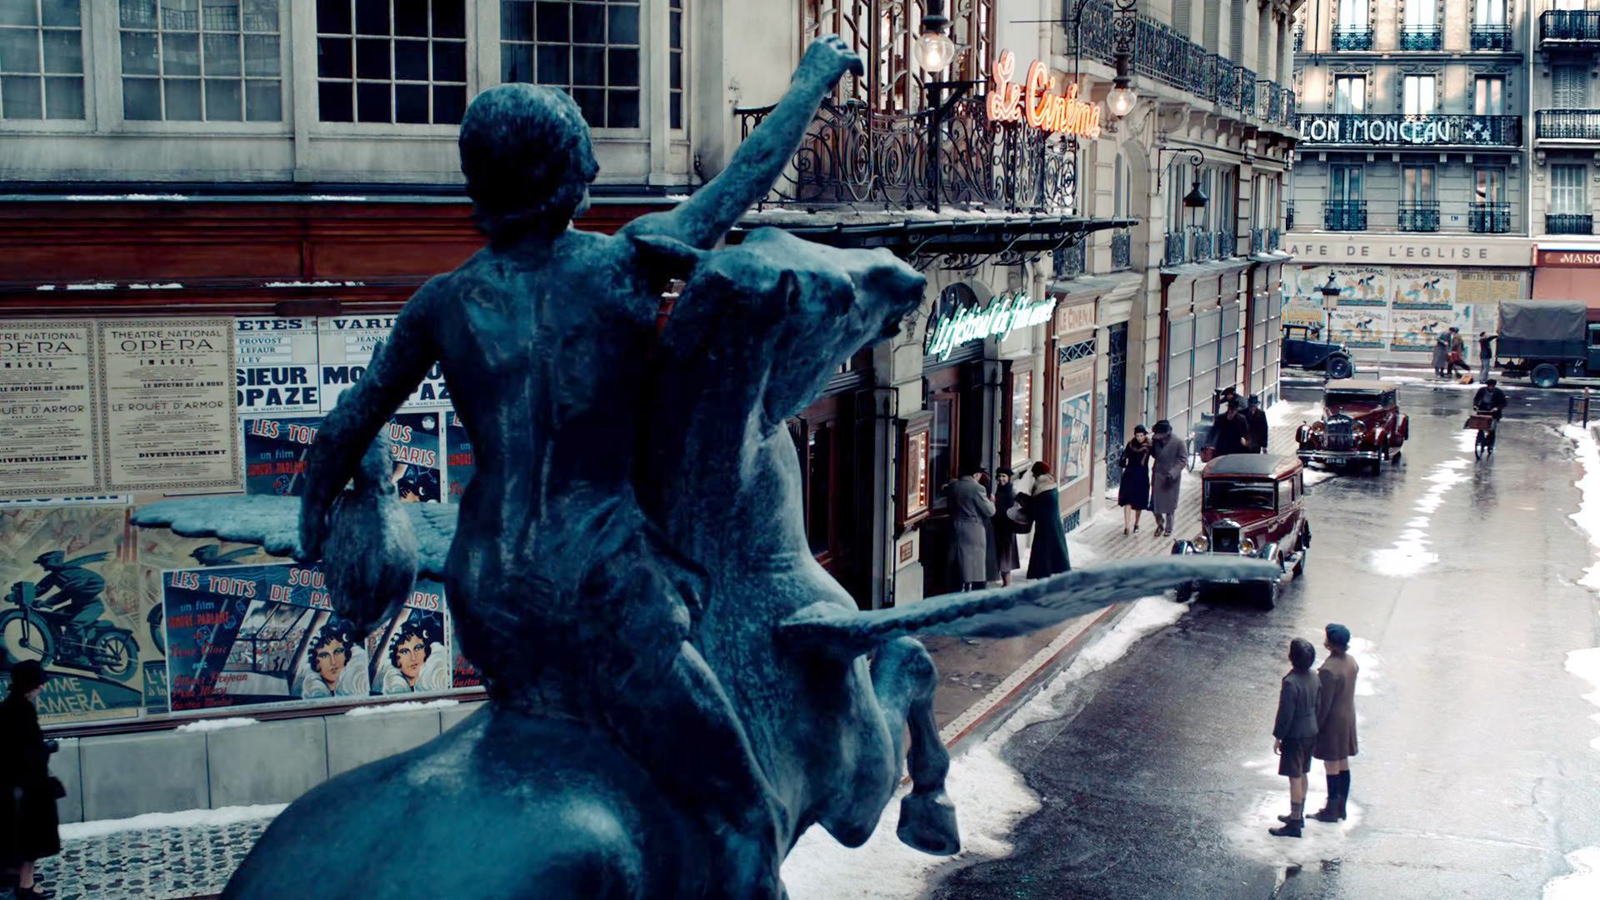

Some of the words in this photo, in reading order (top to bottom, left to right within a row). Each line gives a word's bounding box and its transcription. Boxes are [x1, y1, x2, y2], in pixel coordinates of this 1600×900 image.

[987, 48, 1021, 121] Le
[1026, 60, 1101, 138] Cinéma
[1352, 120, 1450, 143] MONCEAU
[1347, 245, 1370, 257] DE
[1389, 245, 1487, 259] L'EGLISE
[24, 332, 83, 341] NATIONAL
[31, 405, 84, 414] D'ARMOR
[112, 403, 124, 412] LE
[129, 402, 167, 411] ROUET
[173, 401, 224, 410] D'ARMOR
[252, 419, 279, 439] LES
[139, 450, 227, 458] DIVERTISSEMENT
[260, 452, 272, 460] un
[275, 449, 294, 459] film
[171, 571, 201, 591] LES
[208, 574, 257, 598] TOITS
[270, 584, 293, 603] DE
[180, 604, 192, 612] un
[196, 600, 215, 610] film
